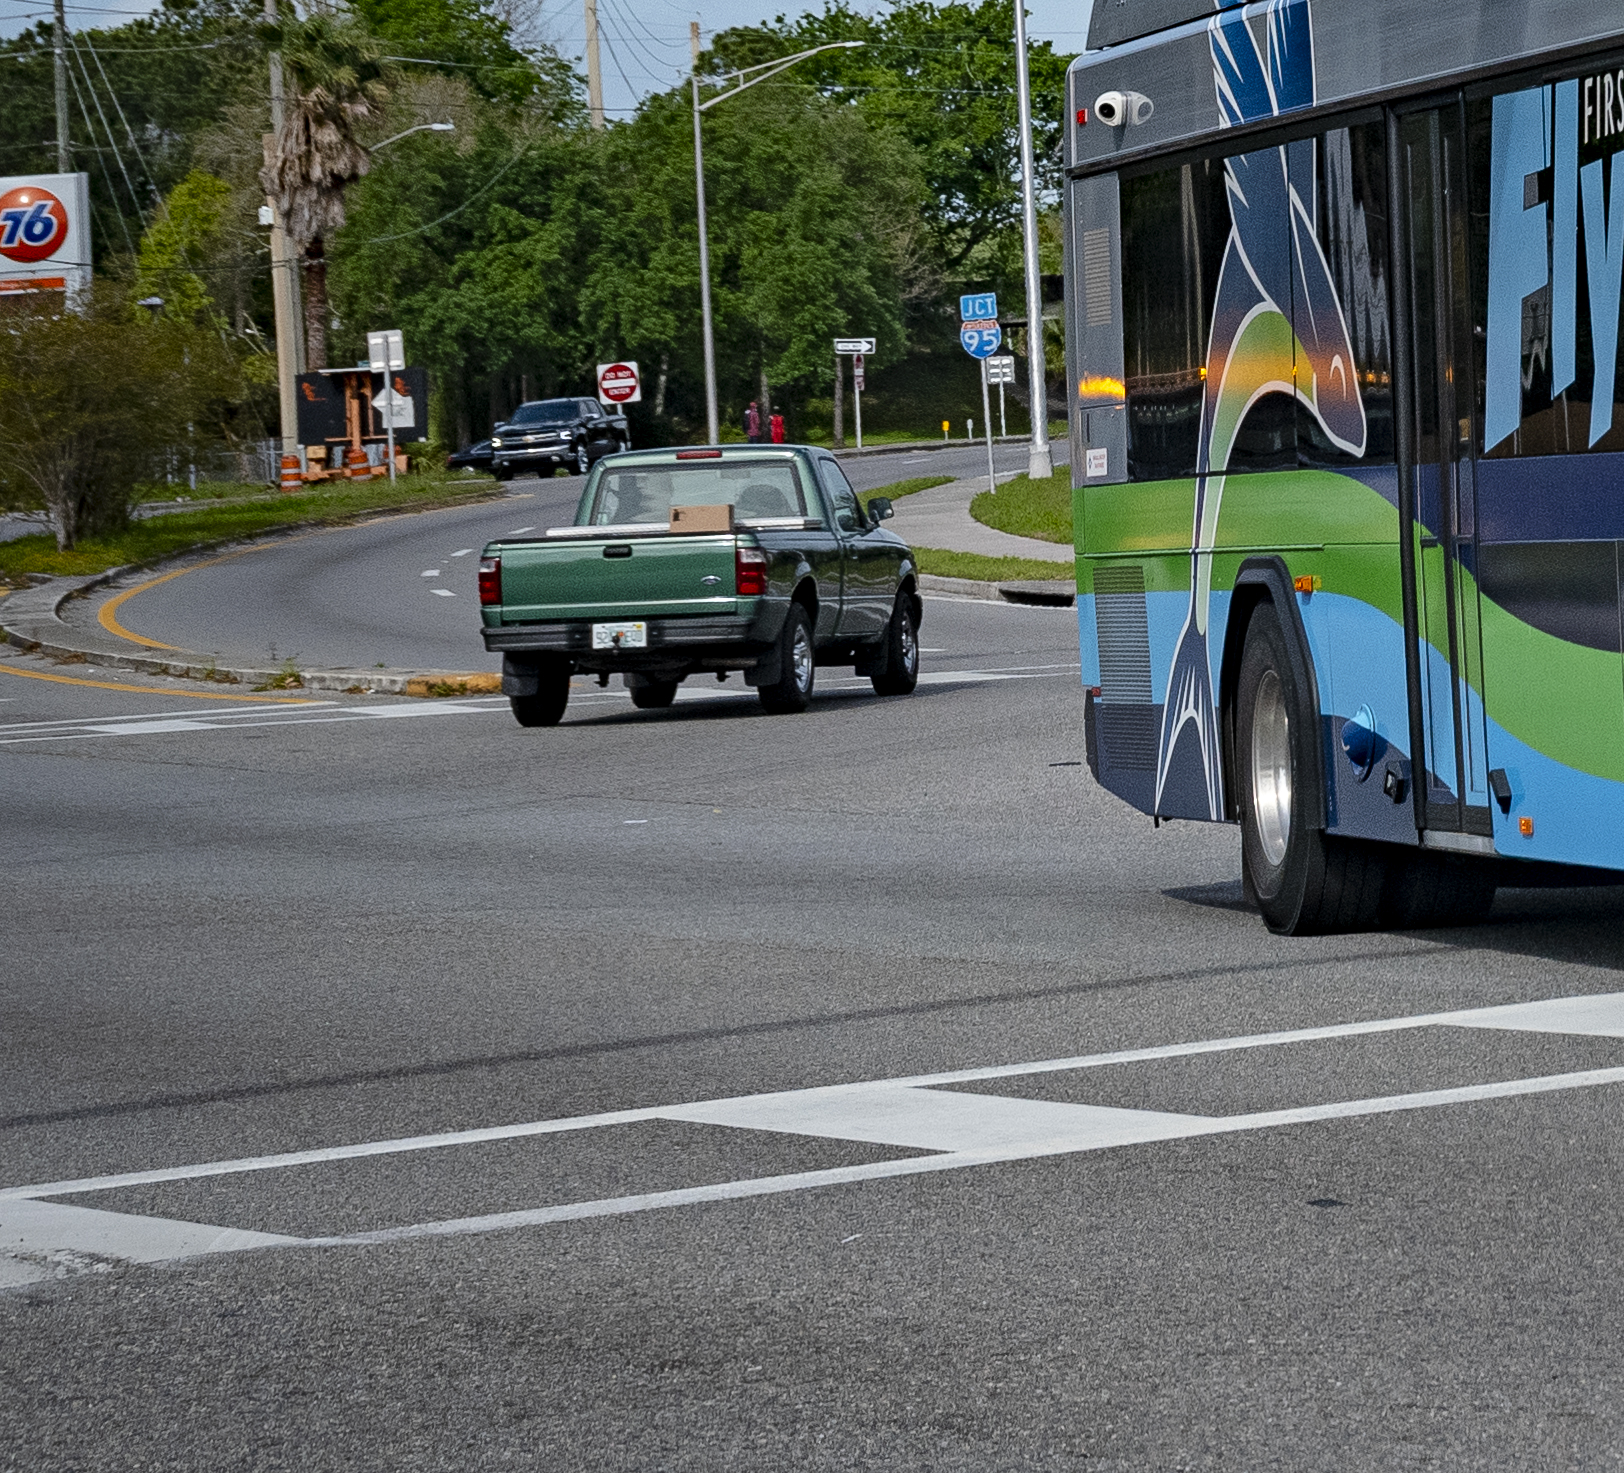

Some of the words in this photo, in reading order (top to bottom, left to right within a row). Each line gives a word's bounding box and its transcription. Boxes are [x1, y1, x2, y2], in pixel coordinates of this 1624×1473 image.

[1, 201, 57, 245] 76
[964, 298, 993, 316] JCT
[964, 330, 998, 352] 95
